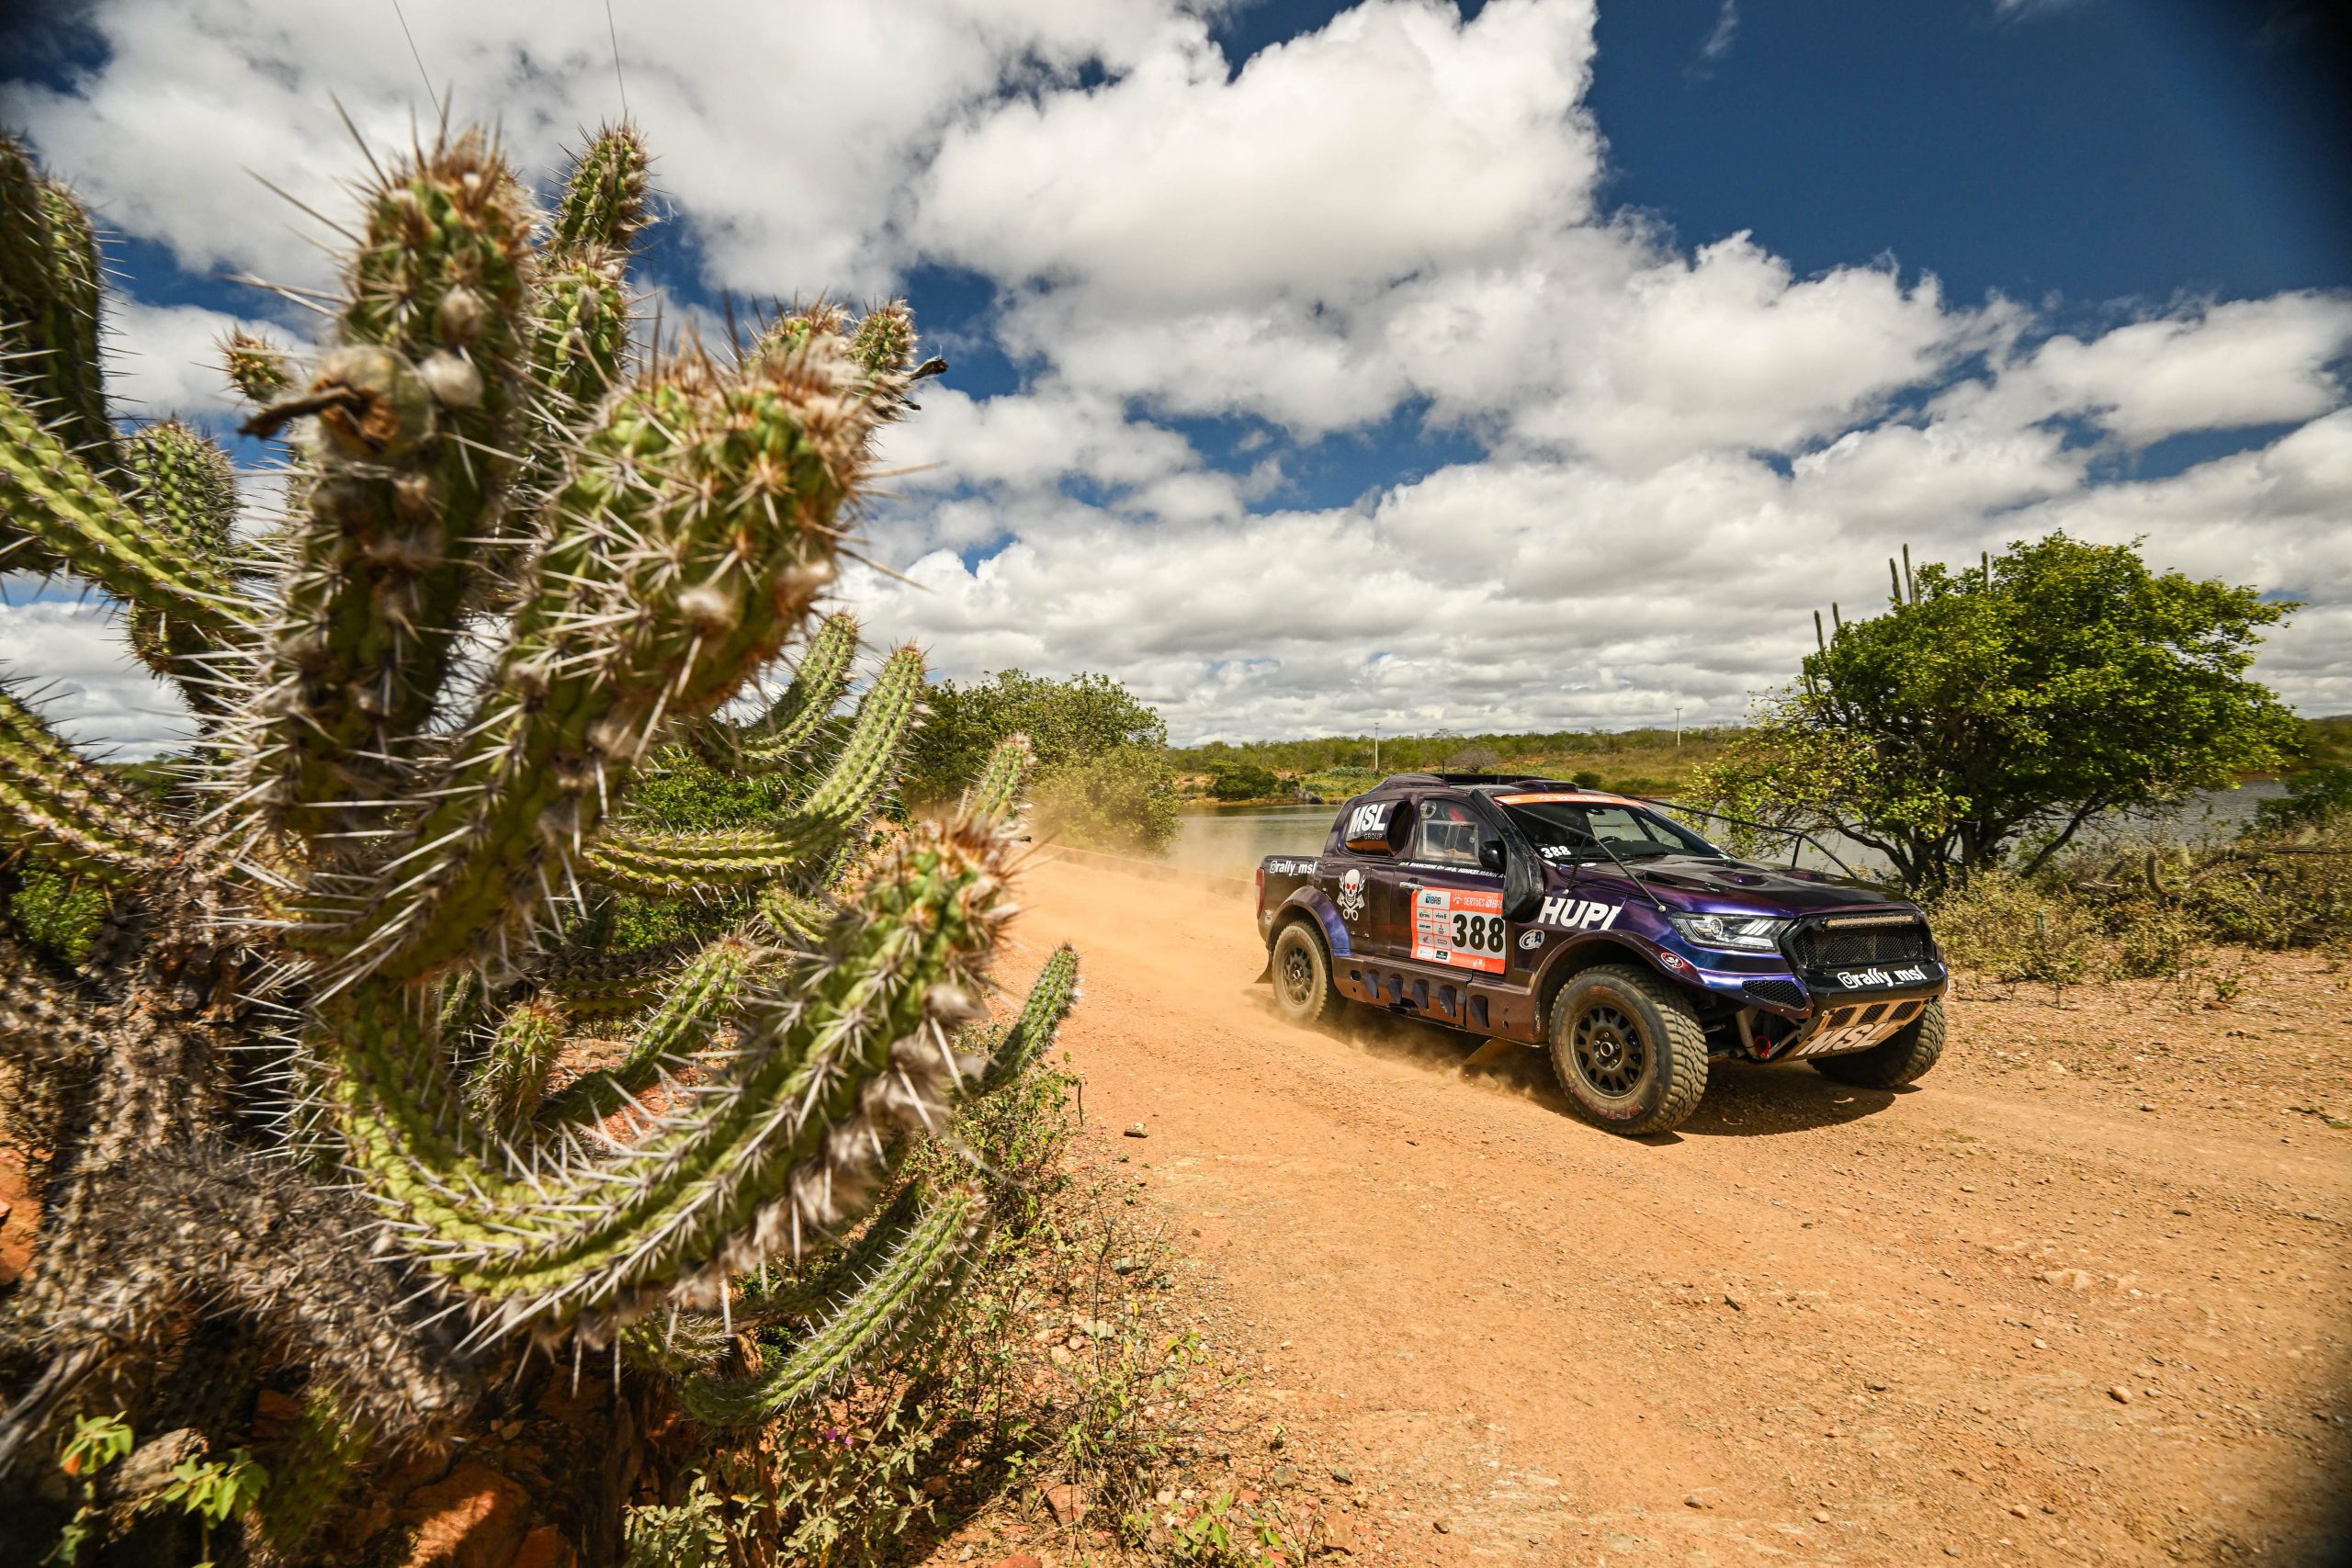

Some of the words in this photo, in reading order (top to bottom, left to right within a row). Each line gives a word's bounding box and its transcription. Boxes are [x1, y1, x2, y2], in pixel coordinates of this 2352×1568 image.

[1347, 804, 1386, 834] MSL
[1541, 845, 1571, 858] 388
[1537, 896, 1623, 931] HUPI
[1452, 913, 1505, 953] 388
[1795, 1021, 1889, 1056] MSL
